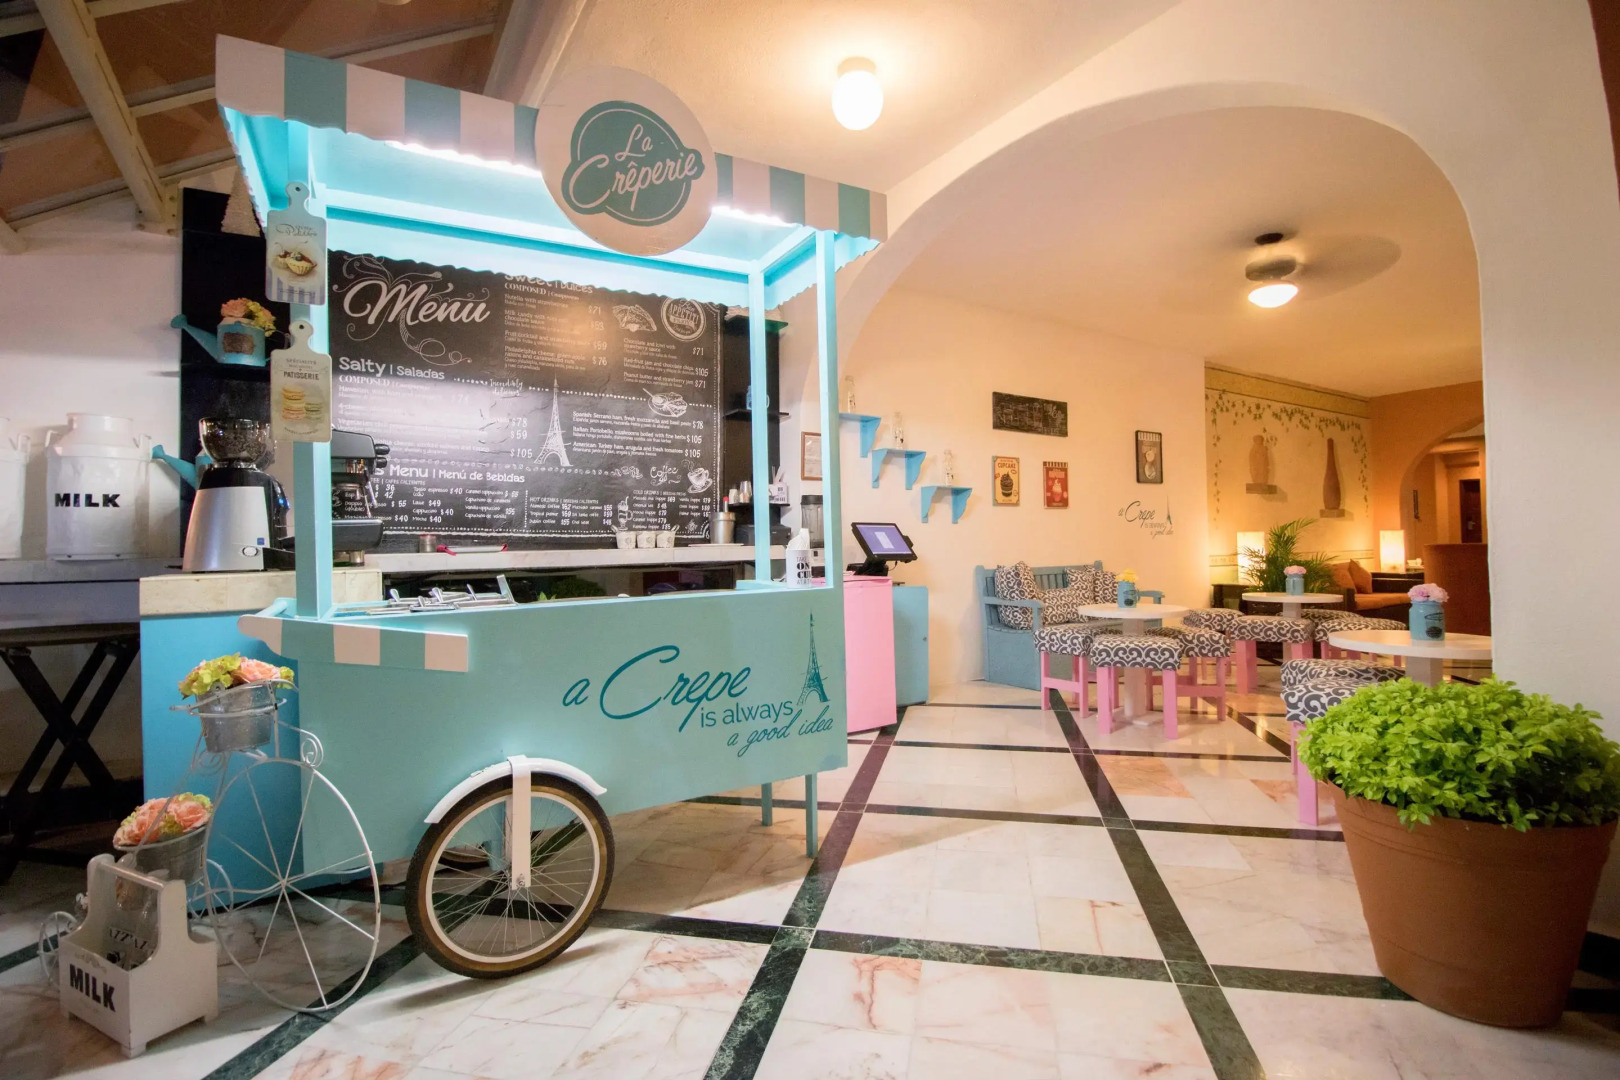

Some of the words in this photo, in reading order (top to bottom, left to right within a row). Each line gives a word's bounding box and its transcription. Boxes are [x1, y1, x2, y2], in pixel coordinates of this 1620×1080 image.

[615, 124, 653, 161] La
[569, 152, 697, 211] Crêperie
[505, 282, 546, 295] COMPOSED
[343, 280, 490, 325] Menu
[693, 348, 704, 356] $71
[284, 371, 319, 380] PATISSERIE
[339, 357, 386, 377] Salty
[396, 365, 445, 380] Saladas
[339, 375, 390, 386] COMPOSED
[695, 380, 706, 388] $71
[685, 449, 700, 458] $105
[390, 464, 428, 477] Menu
[439, 469, 466, 480] Menú
[470, 471, 483, 480] de
[486, 472, 525, 483] Bebidas
[54, 493, 120, 508] MILK
[1125, 501, 1156, 528] Crepe
[562, 678, 590, 706] a
[600, 644, 750, 732] Crepe
[700, 706, 717, 728] is
[722, 700, 794, 725] always
[726, 732, 738, 747] a
[737, 708, 803, 758] good
[798, 704, 834, 736] idea
[69, 964, 116, 1012] MILK
